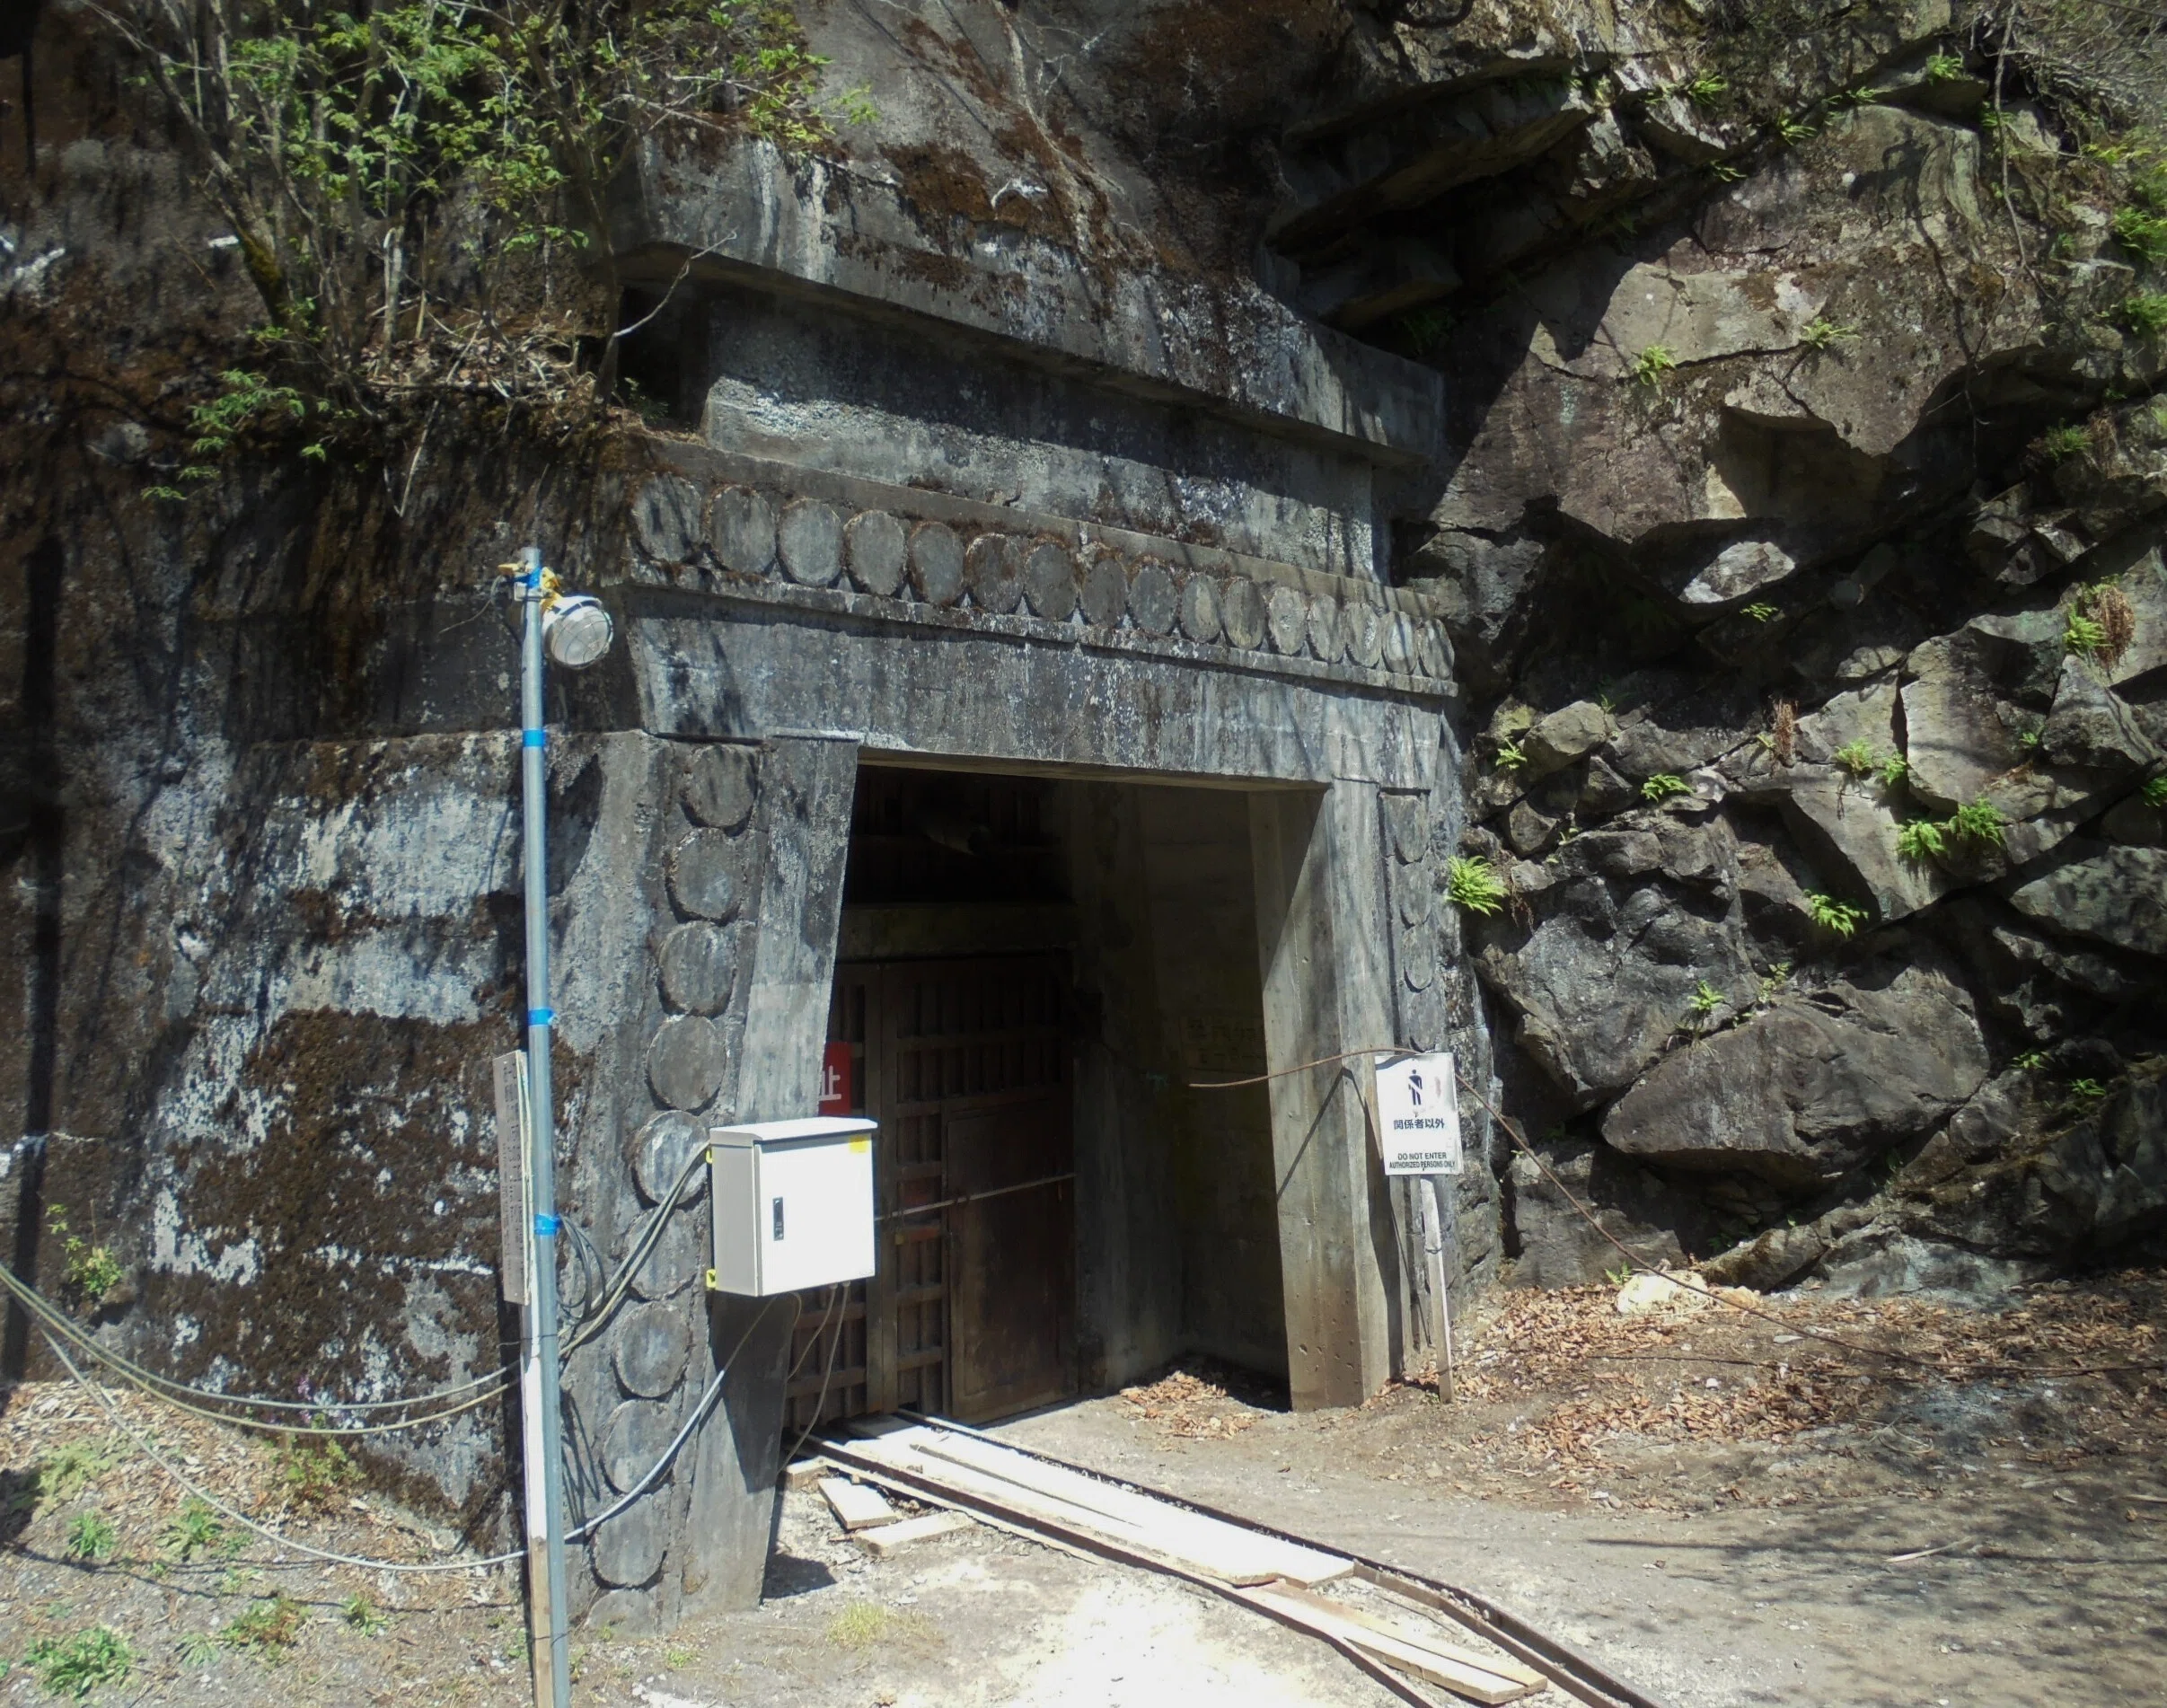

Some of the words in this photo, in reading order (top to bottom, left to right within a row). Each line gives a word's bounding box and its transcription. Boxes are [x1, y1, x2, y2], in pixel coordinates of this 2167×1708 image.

[1394, 1118, 1445, 1130] 関係者以外
[1409, 1152, 1423, 1160] NOT
[1425, 1151, 1447, 1159] ENTER
[1389, 1161, 1420, 1169] AUTHORIZED
